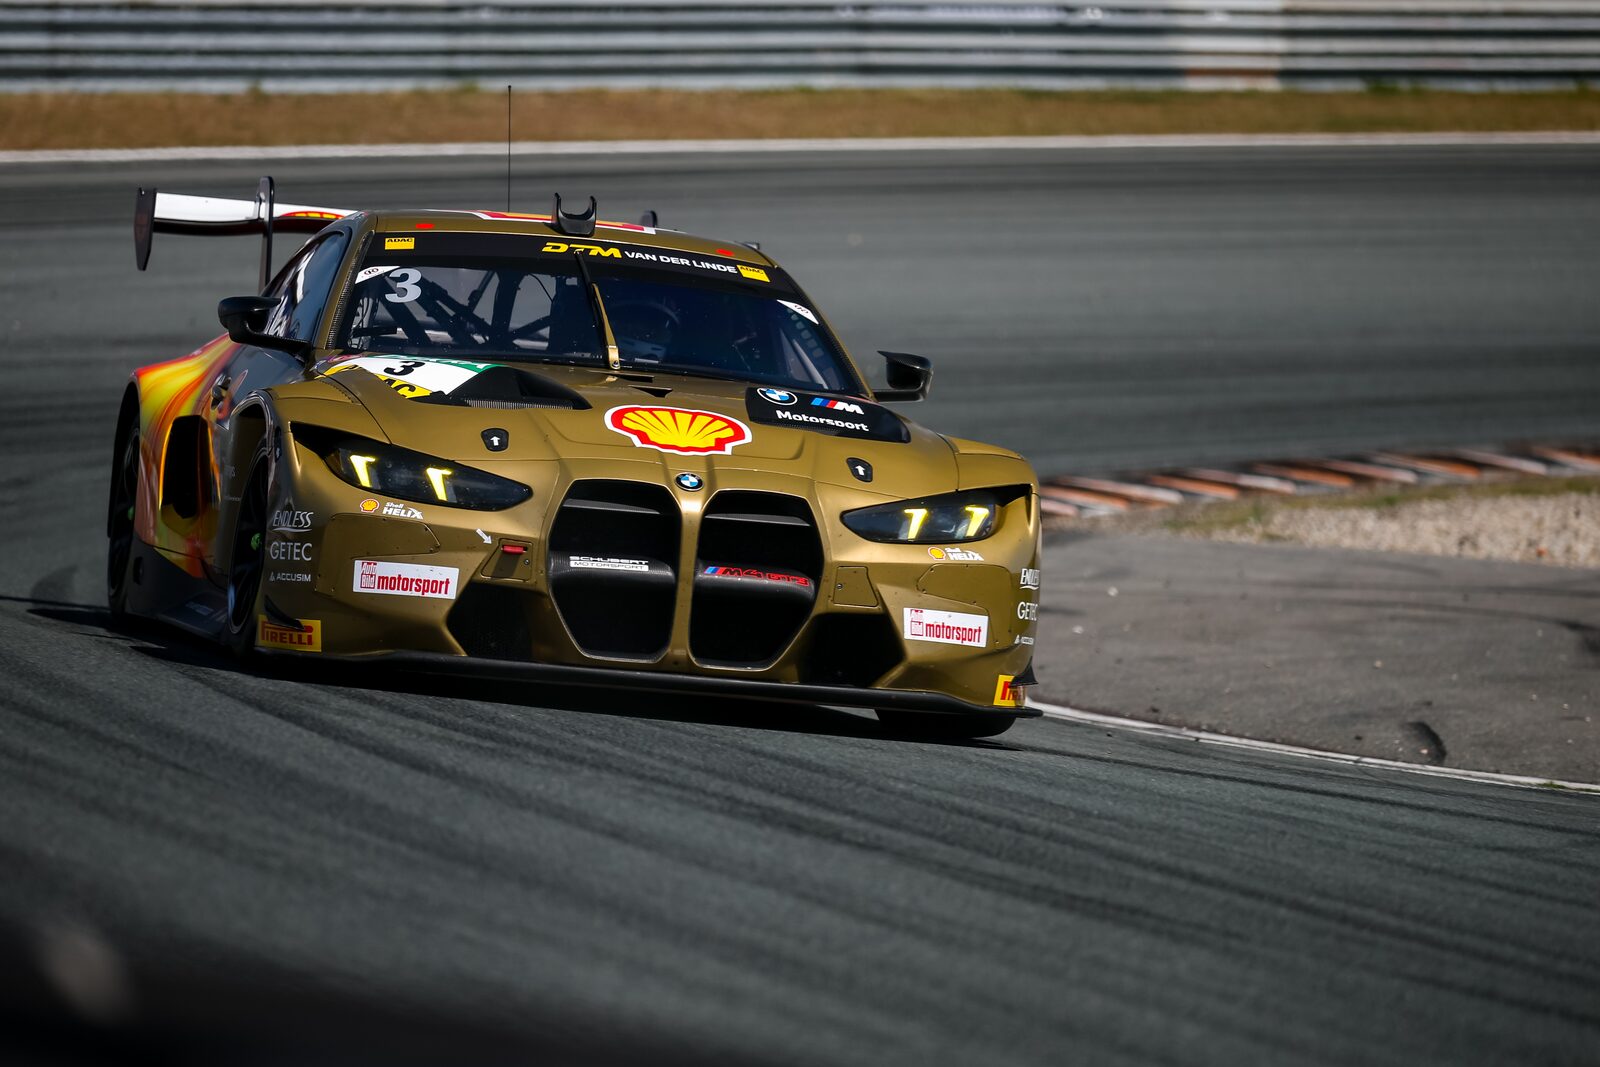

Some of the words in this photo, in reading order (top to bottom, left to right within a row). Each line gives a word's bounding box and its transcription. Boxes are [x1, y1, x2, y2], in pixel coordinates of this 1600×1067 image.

[542, 242, 622, 258] DTM
[624, 250, 657, 261] VAN
[660, 255, 691, 266] DER
[693, 260, 738, 274] LINDE
[385, 268, 421, 303] 3
[384, 361, 425, 376] 3
[776, 410, 869, 431] Motorsport
[272, 510, 314, 528] ENDLESS
[382, 506, 424, 519] HELIX
[270, 541, 313, 561] GETEC
[276, 573, 311, 582] ACCUSIM
[377, 574, 450, 595] motorsport
[925, 622, 981, 643] motorsport
